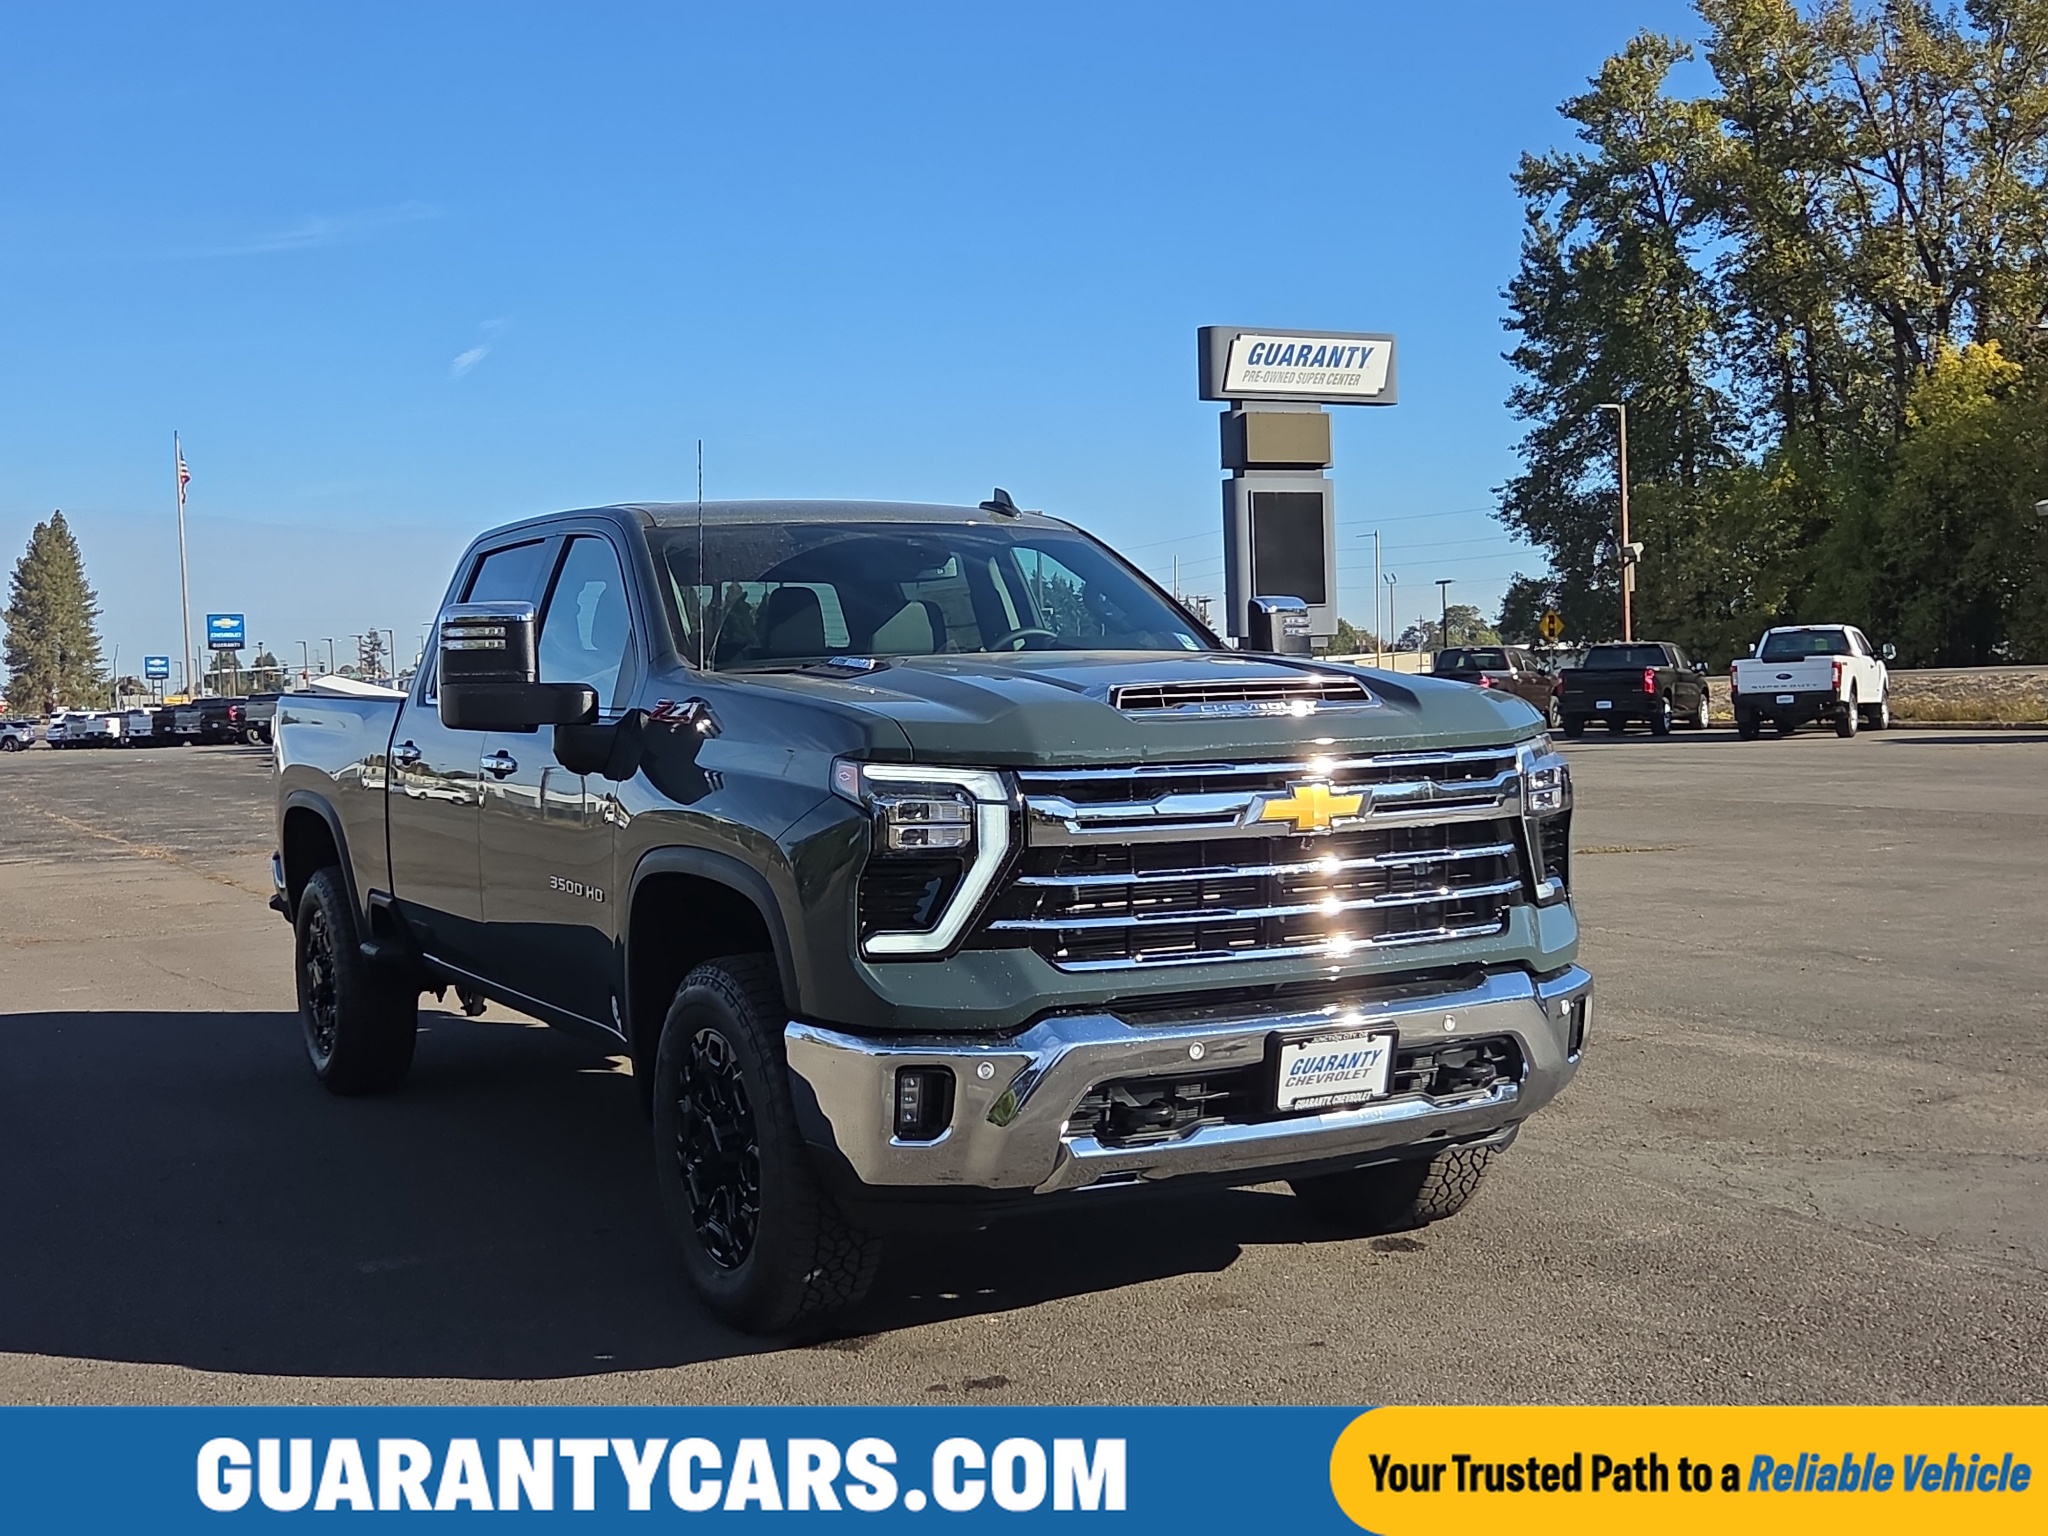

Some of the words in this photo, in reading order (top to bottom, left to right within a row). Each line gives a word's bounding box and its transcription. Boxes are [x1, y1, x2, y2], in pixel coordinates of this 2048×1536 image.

[1248, 342, 1374, 369] GUARANTY
[1242, 369, 1296, 384] PRE-OWNED
[1296, 372, 1326, 385] SUPER
[1326, 373, 1361, 386] CENTER
[549, 875, 583, 897] 3500
[585, 885, 605, 902] HD
[1290, 1049, 1383, 1076] GUARANTY
[1285, 1068, 1371, 1087] CHEVROLET
